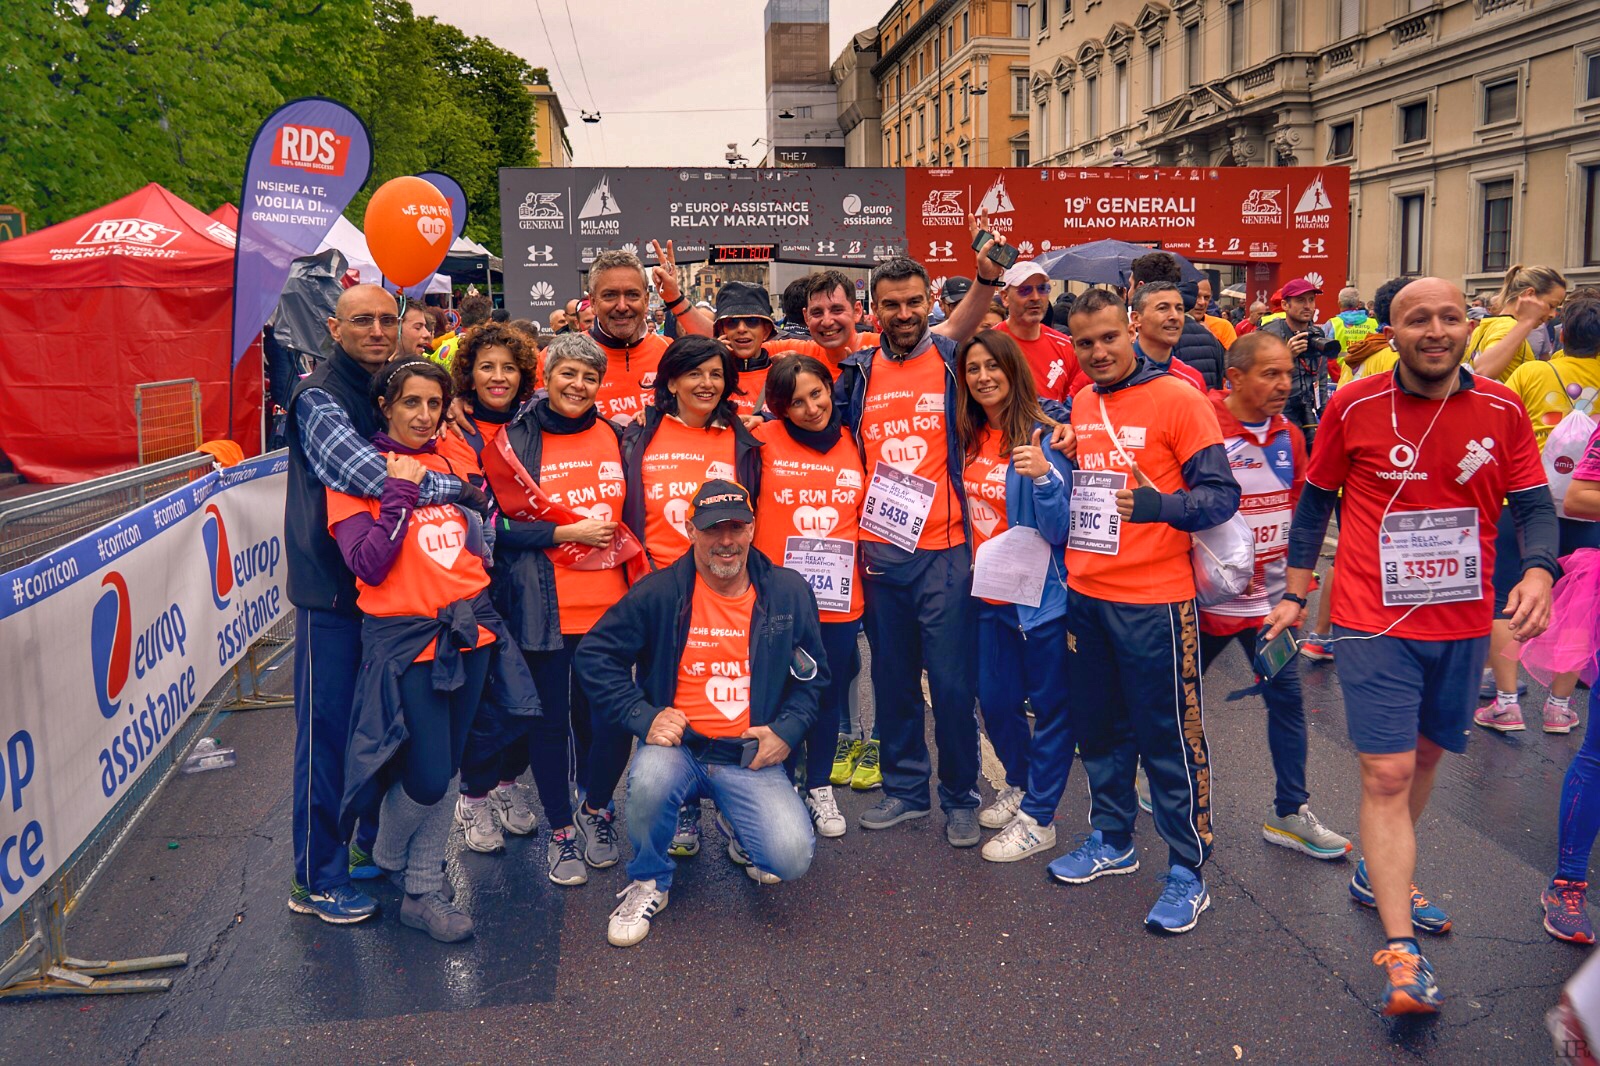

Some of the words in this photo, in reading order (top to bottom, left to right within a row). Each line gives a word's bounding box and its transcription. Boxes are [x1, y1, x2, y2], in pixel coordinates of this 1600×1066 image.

[281, 126, 336, 165] RDS
[780, 152, 800, 160] THE
[802, 152, 808, 160] 7
[256, 180, 300, 193] INSIEME
[302, 186, 310, 194] A
[312, 186, 327, 198] TE,
[255, 195, 304, 210] VOGLIA
[402, 204, 418, 216] WE
[420, 205, 438, 216] RUN
[686, 202, 728, 213] EUROP
[733, 202, 809, 213] ASSISTANCE
[862, 204, 892, 216] europ
[1097, 197, 1196, 214] GENERALI
[252, 212, 288, 224] GRANDI
[291, 215, 327, 226] EVENTI!
[519, 220, 564, 230] GENERALI
[580, 220, 620, 229] MILANO
[670, 215, 719, 228] RELAY
[724, 214, 810, 227] MARATHON
[843, 216, 892, 226] assistance
[922, 216, 964, 226] GENERALI
[977, 218, 1013, 226] MLANO
[1064, 217, 1116, 228] MILANO
[1120, 216, 1195, 228] MARATHON
[1242, 215, 1282, 225] GENERALI
[1296, 215, 1330, 224] MILANO
[93, 220, 161, 241] RDS
[422, 224, 444, 234] LILT
[52, 250, 110, 260] GRANDI
[883, 390, 914, 400] SPECIALI
[609, 396, 638, 412] RUN
[864, 424, 882, 441] WE
[884, 418, 910, 438] RUN
[912, 415, 942, 430] FOR
[670, 452, 705, 462] SPECIALI
[888, 446, 924, 463] LILT
[1084, 452, 1106, 470] RUN
[558, 460, 592, 470] SPECIALI
[773, 460, 799, 469] AMICHE
[802, 462, 834, 472] SPECIALI
[1554, 460, 1574, 468] amis
[1376, 470, 1428, 480] vodafone
[566, 486, 596, 506] RUN
[598, 482, 622, 498] FOR
[647, 483, 664, 500] WE
[668, 482, 698, 498] RUN
[774, 488, 794, 505] WE
[800, 488, 826, 504] RUN
[832, 488, 856, 505] FOR
[888, 490, 916, 504] MARATHON
[890, 485, 910, 496] RELAY
[982, 482, 1006, 500] FOR
[152, 497, 188, 530] #corricon
[412, 506, 445, 523] RUN
[442, 504, 462, 518] FO
[878, 502, 909, 526] 543B
[1080, 512, 1102, 530] 501C
[800, 517, 836, 531] LILT
[97, 523, 142, 562] #corricon
[426, 530, 462, 552] LILT
[234, 535, 280, 588] europ
[1404, 558, 1460, 580] 3357D
[12, 554, 79, 606] #corricon
[800, 574, 834, 590] 43A
[1404, 592, 1434, 600] UNDE
[1434, 590, 1472, 598] ARMOUR
[217, 584, 281, 668] assistance
[710, 628, 745, 637] SPECIALI
[134, 602, 187, 680] europ
[711, 661, 741, 676] RUN
[1182, 680, 1208, 764] COMBAT
[98, 664, 196, 799] assistance
[1196, 767, 1210, 808] ARE
